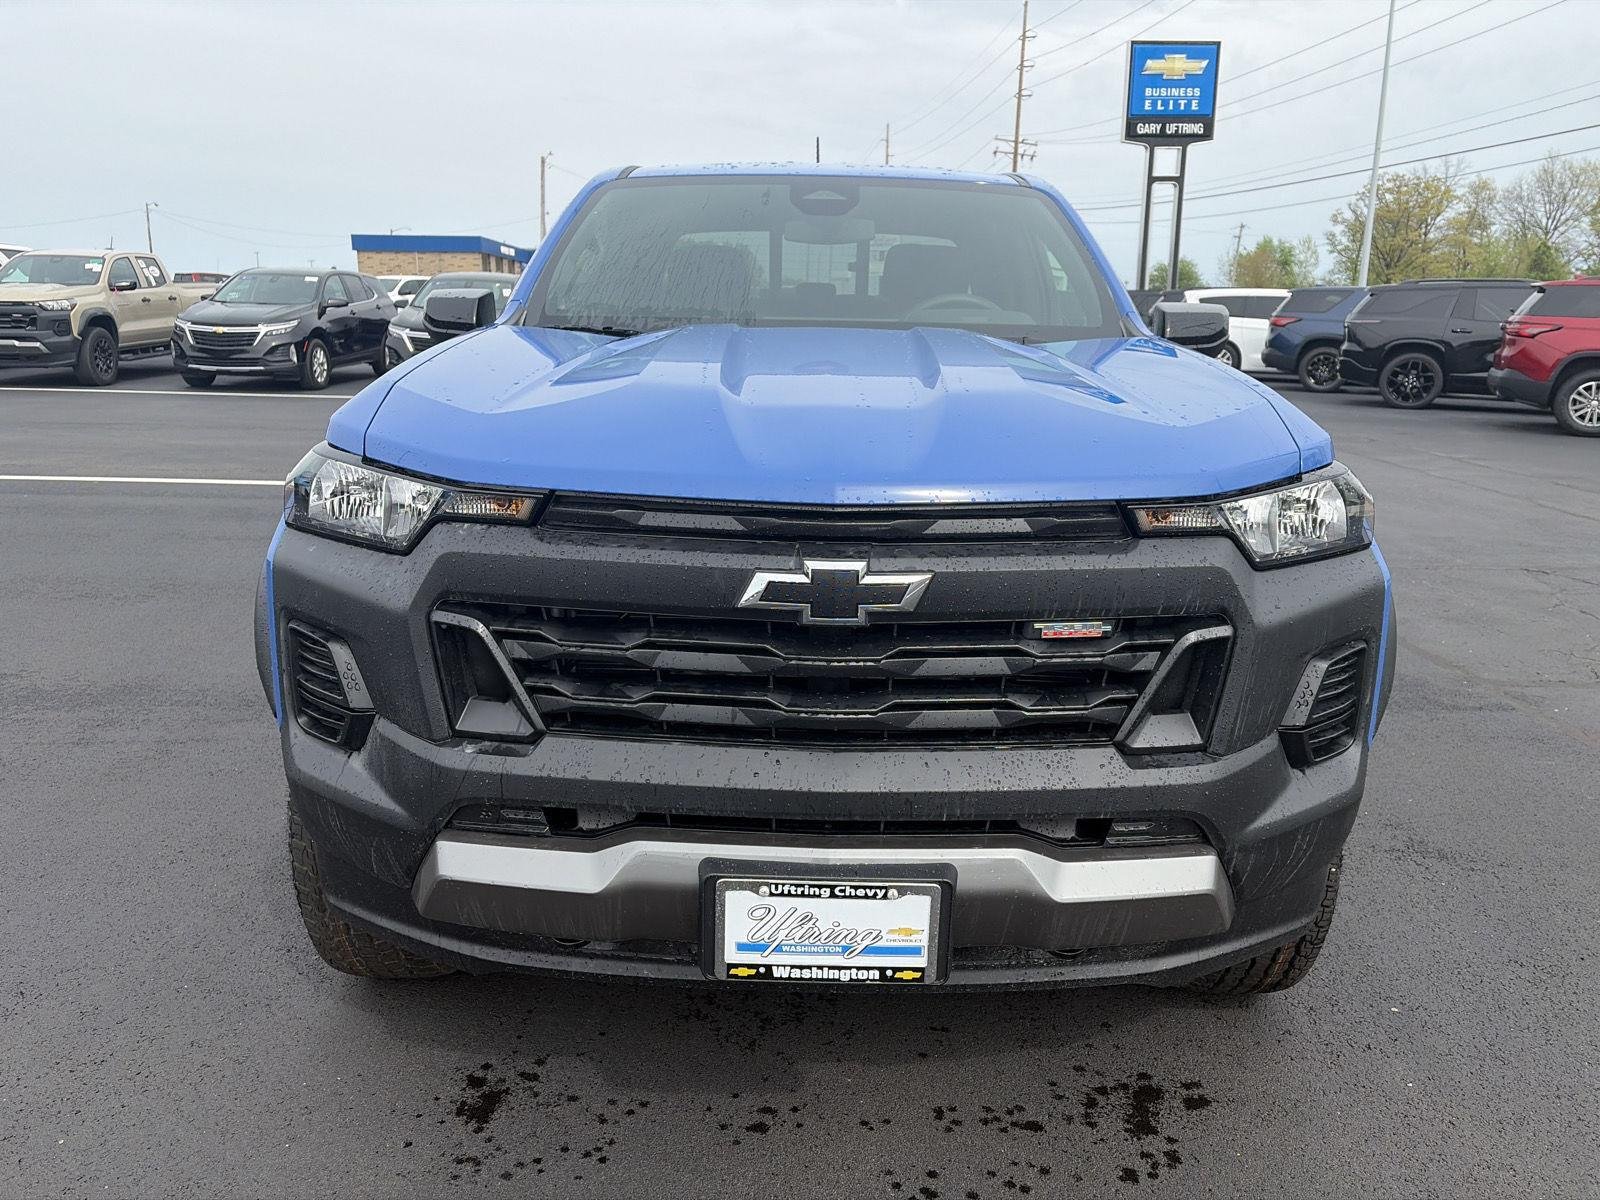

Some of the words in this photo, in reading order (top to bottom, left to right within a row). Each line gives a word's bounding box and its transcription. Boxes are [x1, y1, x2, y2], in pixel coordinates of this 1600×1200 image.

[1145, 88, 1200, 96] BUSINESS
[1144, 100, 1199, 110] ELITE
[1137, 123, 1162, 134] GARY
[1166, 123, 1204, 134] UFTRING
[770, 884, 831, 897] Uftring
[834, 886, 887, 898] Chevy
[747, 904, 883, 959] Uftring
[782, 945, 842, 953] WASHINGTON
[772, 966, 880, 981] Washington
